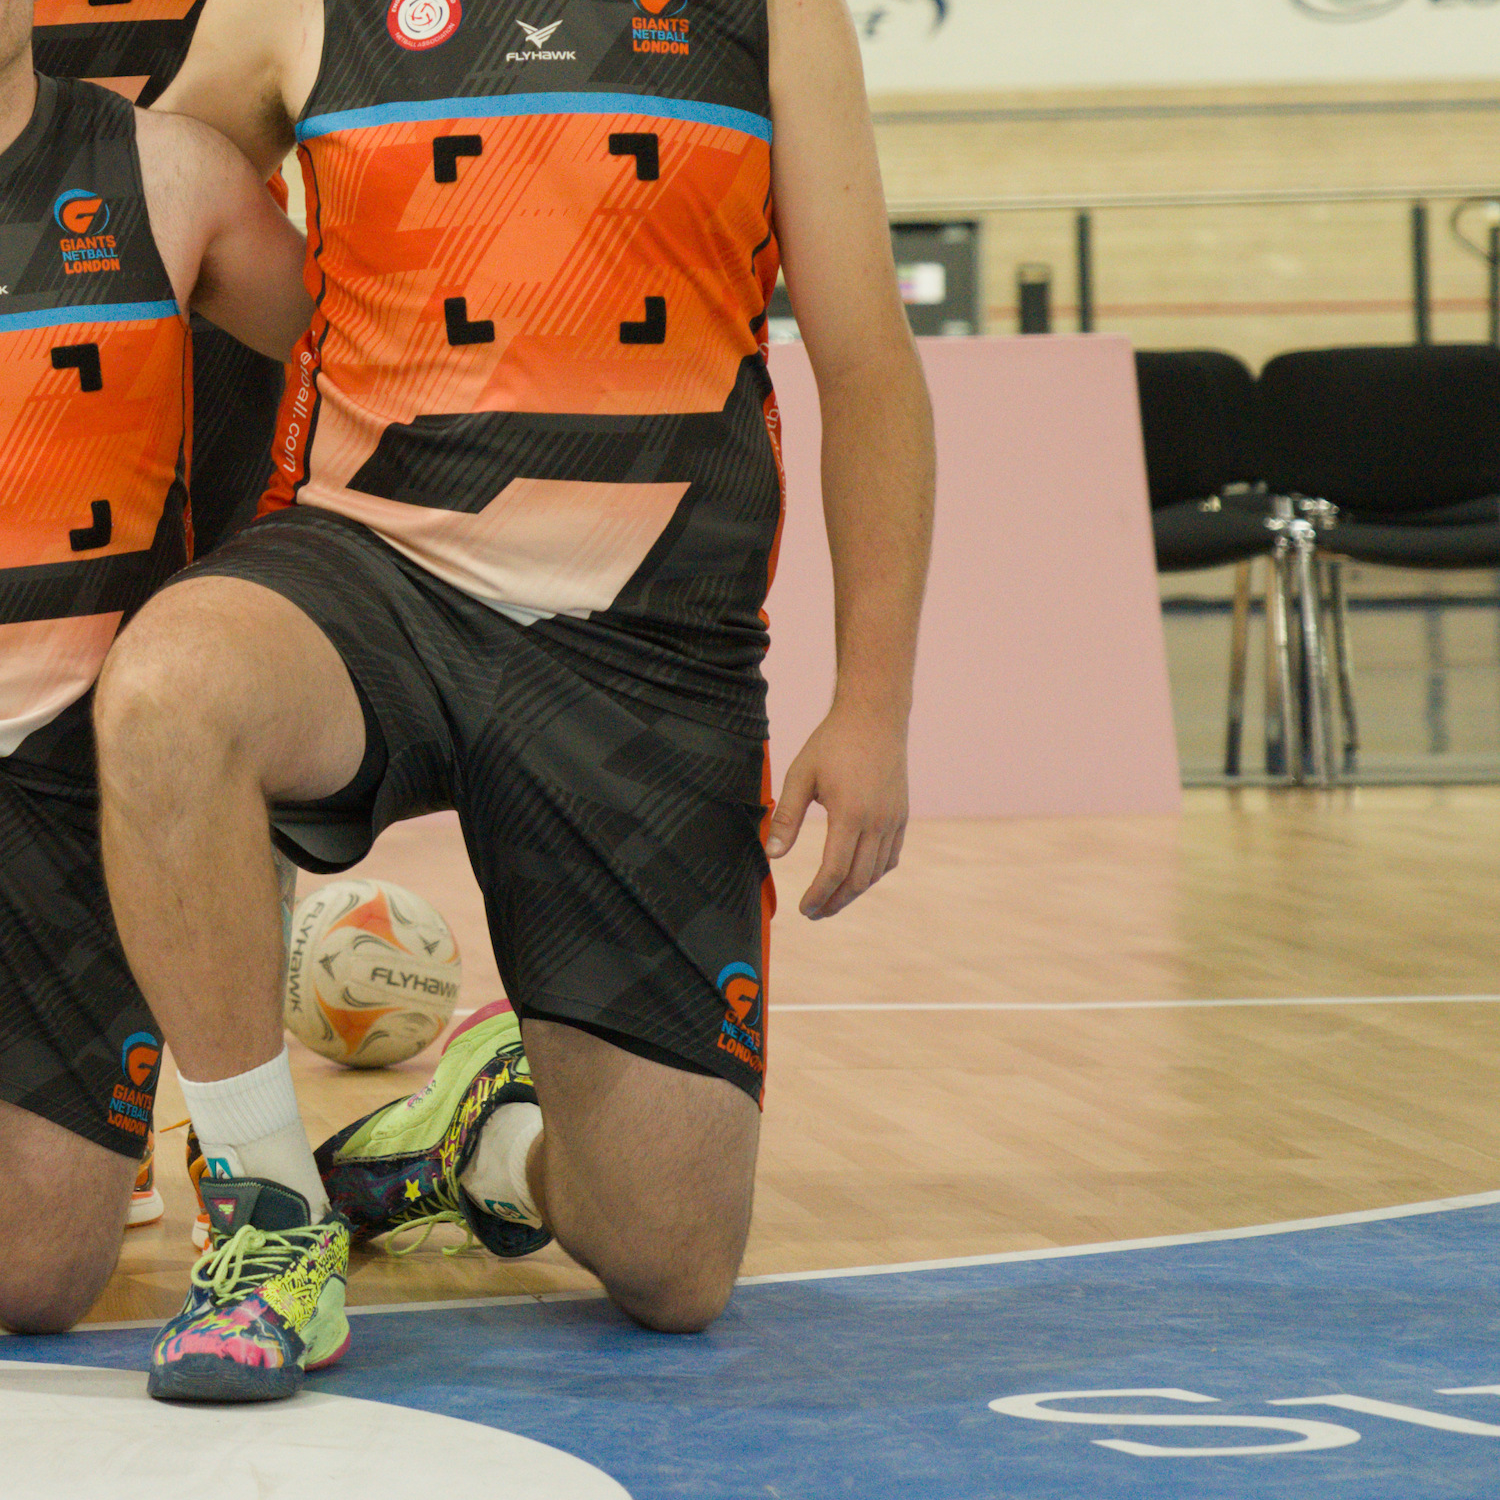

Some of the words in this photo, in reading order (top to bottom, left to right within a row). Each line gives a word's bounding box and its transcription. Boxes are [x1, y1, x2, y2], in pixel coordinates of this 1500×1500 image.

[631, 17, 689, 33] GIANTS
[632, 29, 689, 43] NETBALL
[633, 39, 689, 55] LONDON
[60, 235, 116, 253] GIANTS
[62, 248, 118, 262] NETBALL
[65, 259, 120, 275] LONDON
[112, 1083, 154, 1111] GIANTS
[109, 1098, 151, 1123] NETBALL
[107, 1111, 147, 1137] LONDON
